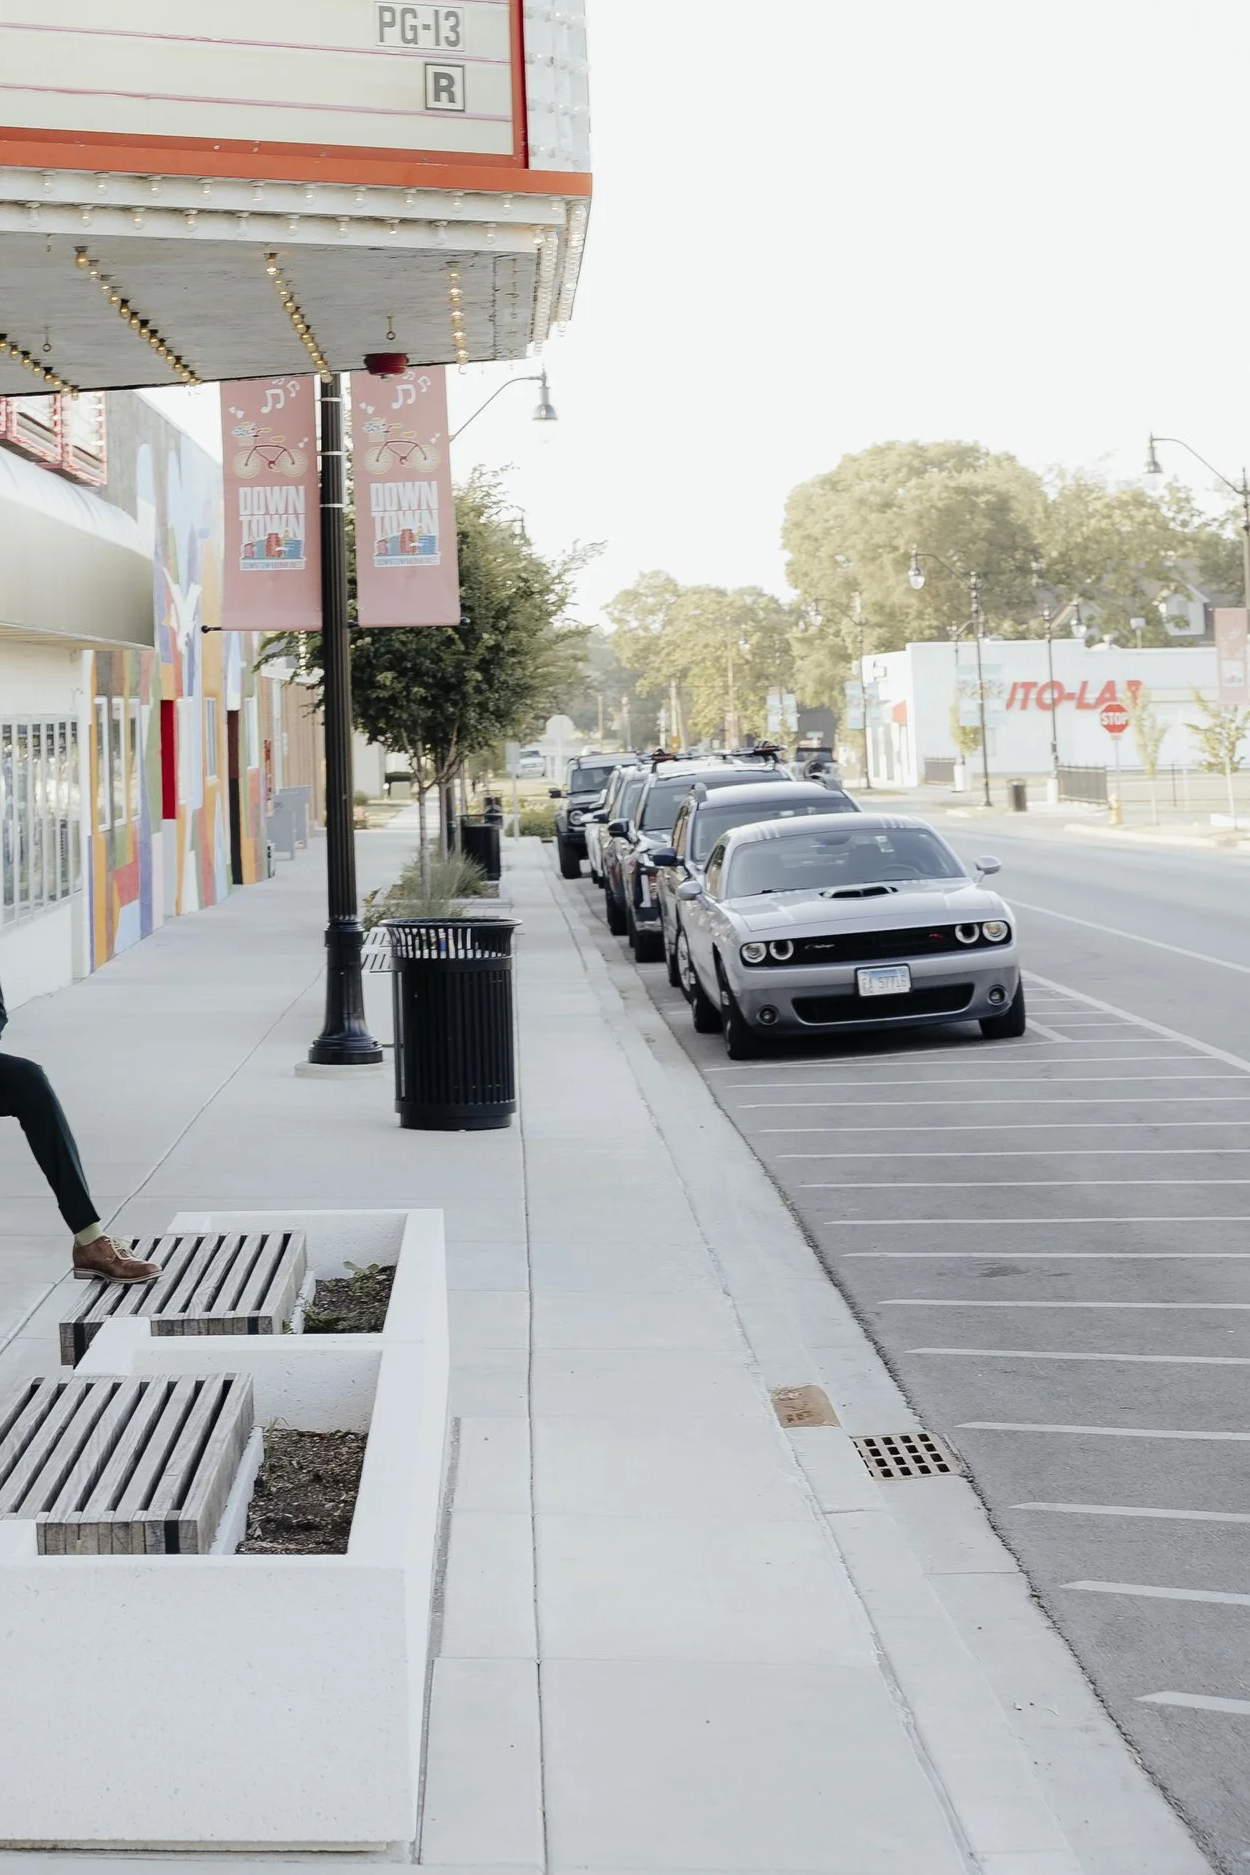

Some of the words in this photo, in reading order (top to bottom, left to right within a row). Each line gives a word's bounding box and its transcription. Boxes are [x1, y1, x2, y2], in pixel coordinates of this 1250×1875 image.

[377, 5, 461, 48] PG-13
[433, 71, 456, 104] R
[238, 485, 306, 515] DOWN
[369, 481, 439, 513] DOWN
[1101, 711, 1130, 726] STOP
